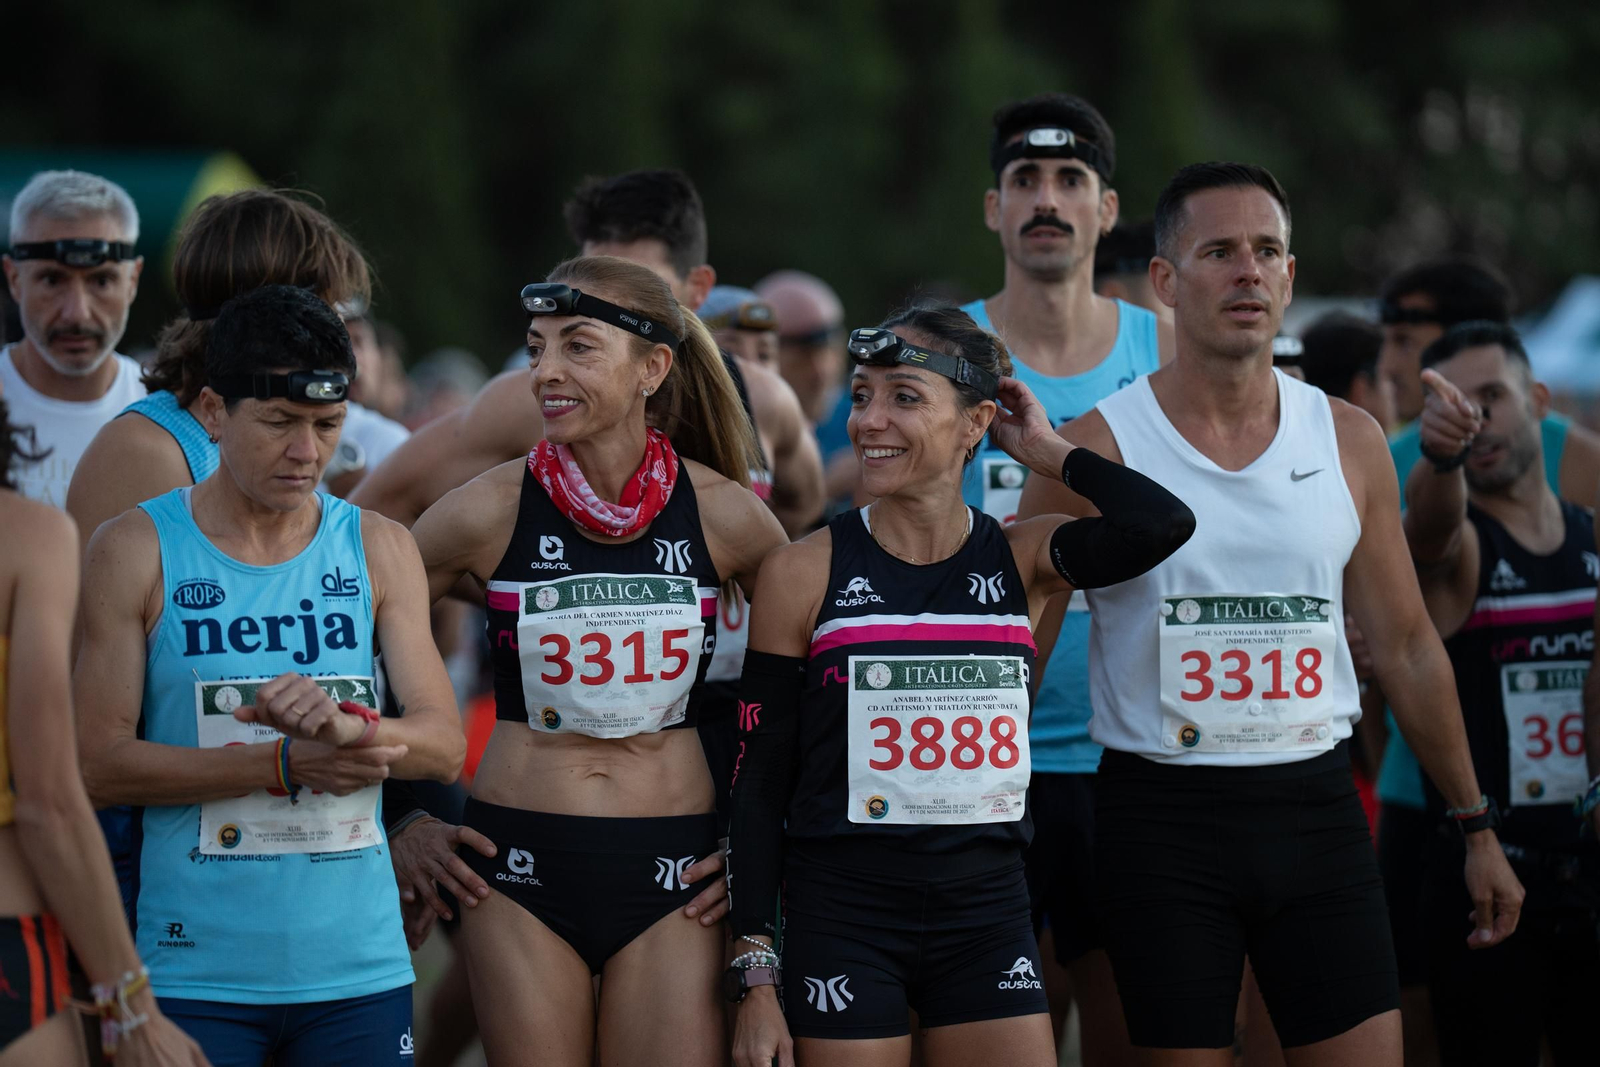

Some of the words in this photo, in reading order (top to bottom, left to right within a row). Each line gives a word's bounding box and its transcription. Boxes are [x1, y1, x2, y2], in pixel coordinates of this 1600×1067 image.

[176, 584, 225, 604] TROPS
[570, 578, 656, 600] ITÁLICA
[836, 594, 885, 607] austral
[1213, 599, 1294, 618] ITÁLICA
[624, 609, 664, 617] MARTÍNEZ
[665, 608, 683, 616] DÍAZ
[182, 599, 358, 665] nerja
[586, 619, 646, 627] INDEPENDIENTE
[1264, 628, 1312, 636] BALLESTEROS
[539, 628, 690, 686] 3315
[904, 662, 987, 684] ITÁLICA
[1180, 647, 1323, 702] 3318
[925, 694, 964, 702] MARTÍNEZ
[966, 694, 998, 702] CARRIÓN
[868, 715, 1020, 771] 3888
[496, 871, 543, 887] austral
[998, 980, 1042, 990] austral
